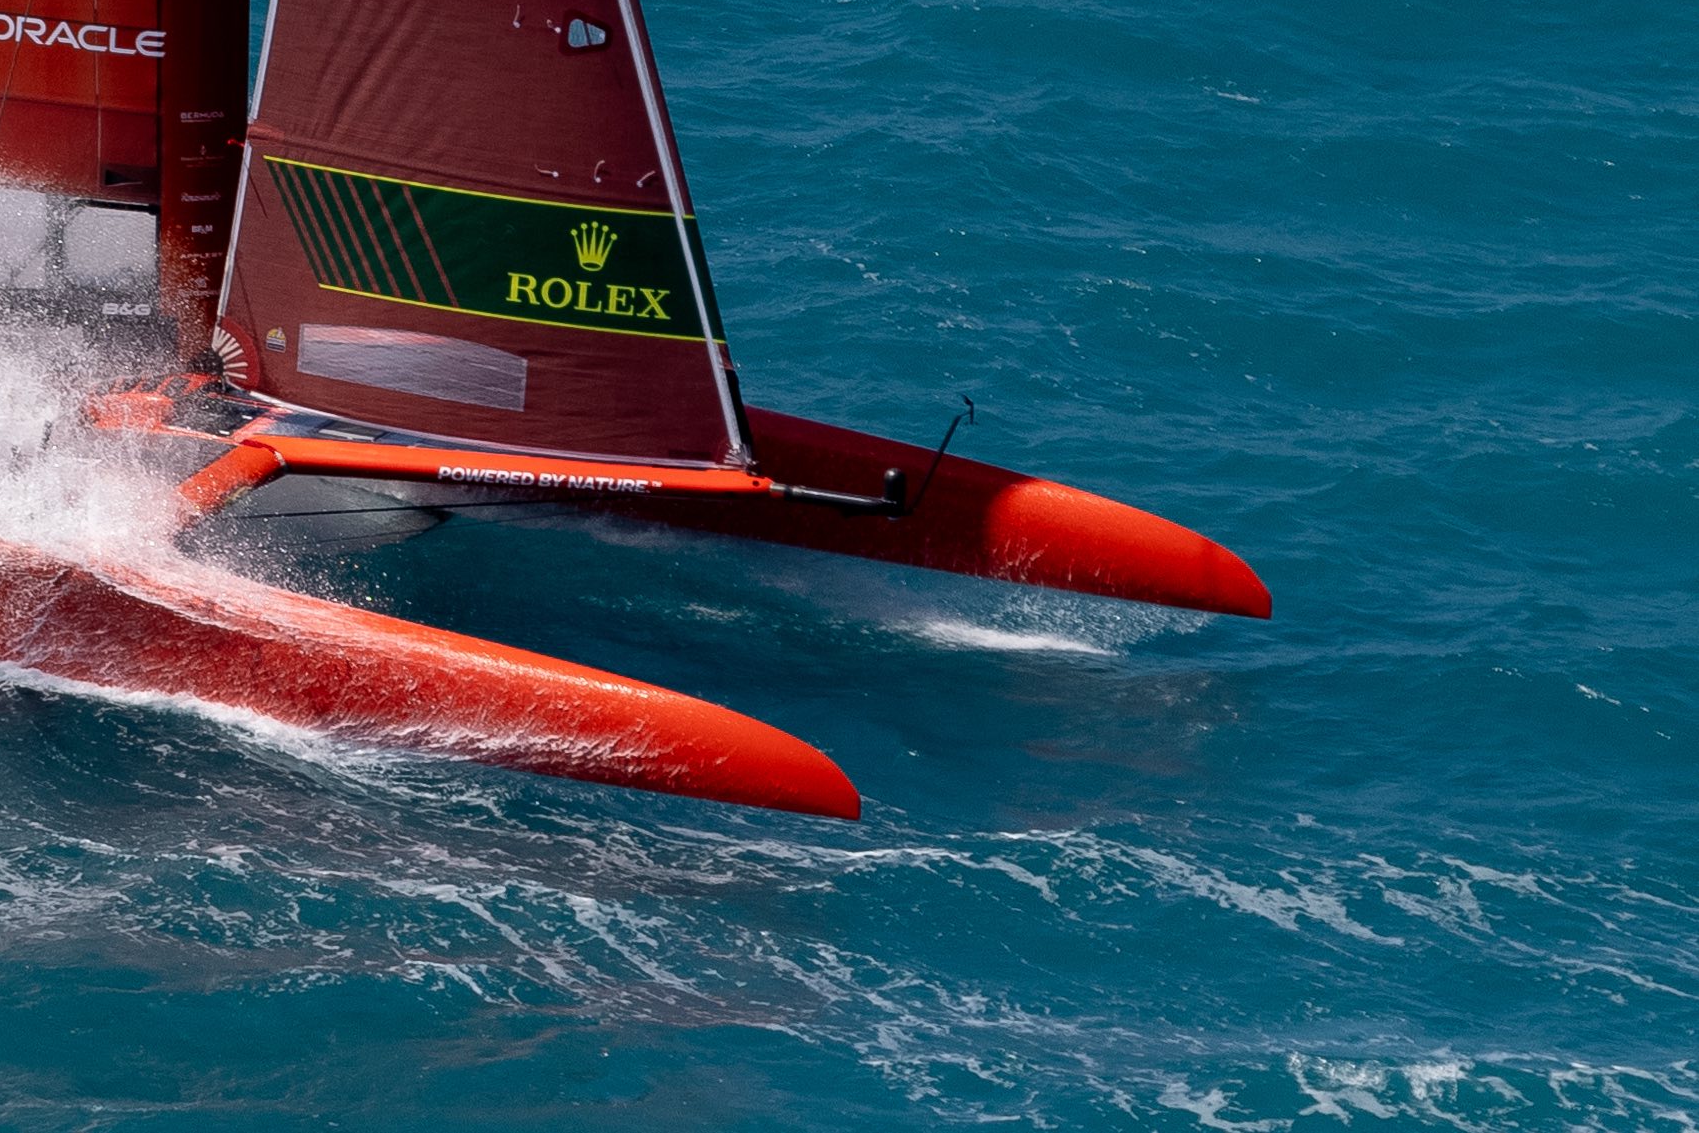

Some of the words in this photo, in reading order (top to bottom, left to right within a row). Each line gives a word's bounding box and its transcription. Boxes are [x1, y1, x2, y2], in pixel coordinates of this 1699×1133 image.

[506, 272, 671, 321] ROLEX
[102, 302, 151, 316] B&G
[437, 466, 535, 486] POWERED
[538, 472, 567, 487] BY
